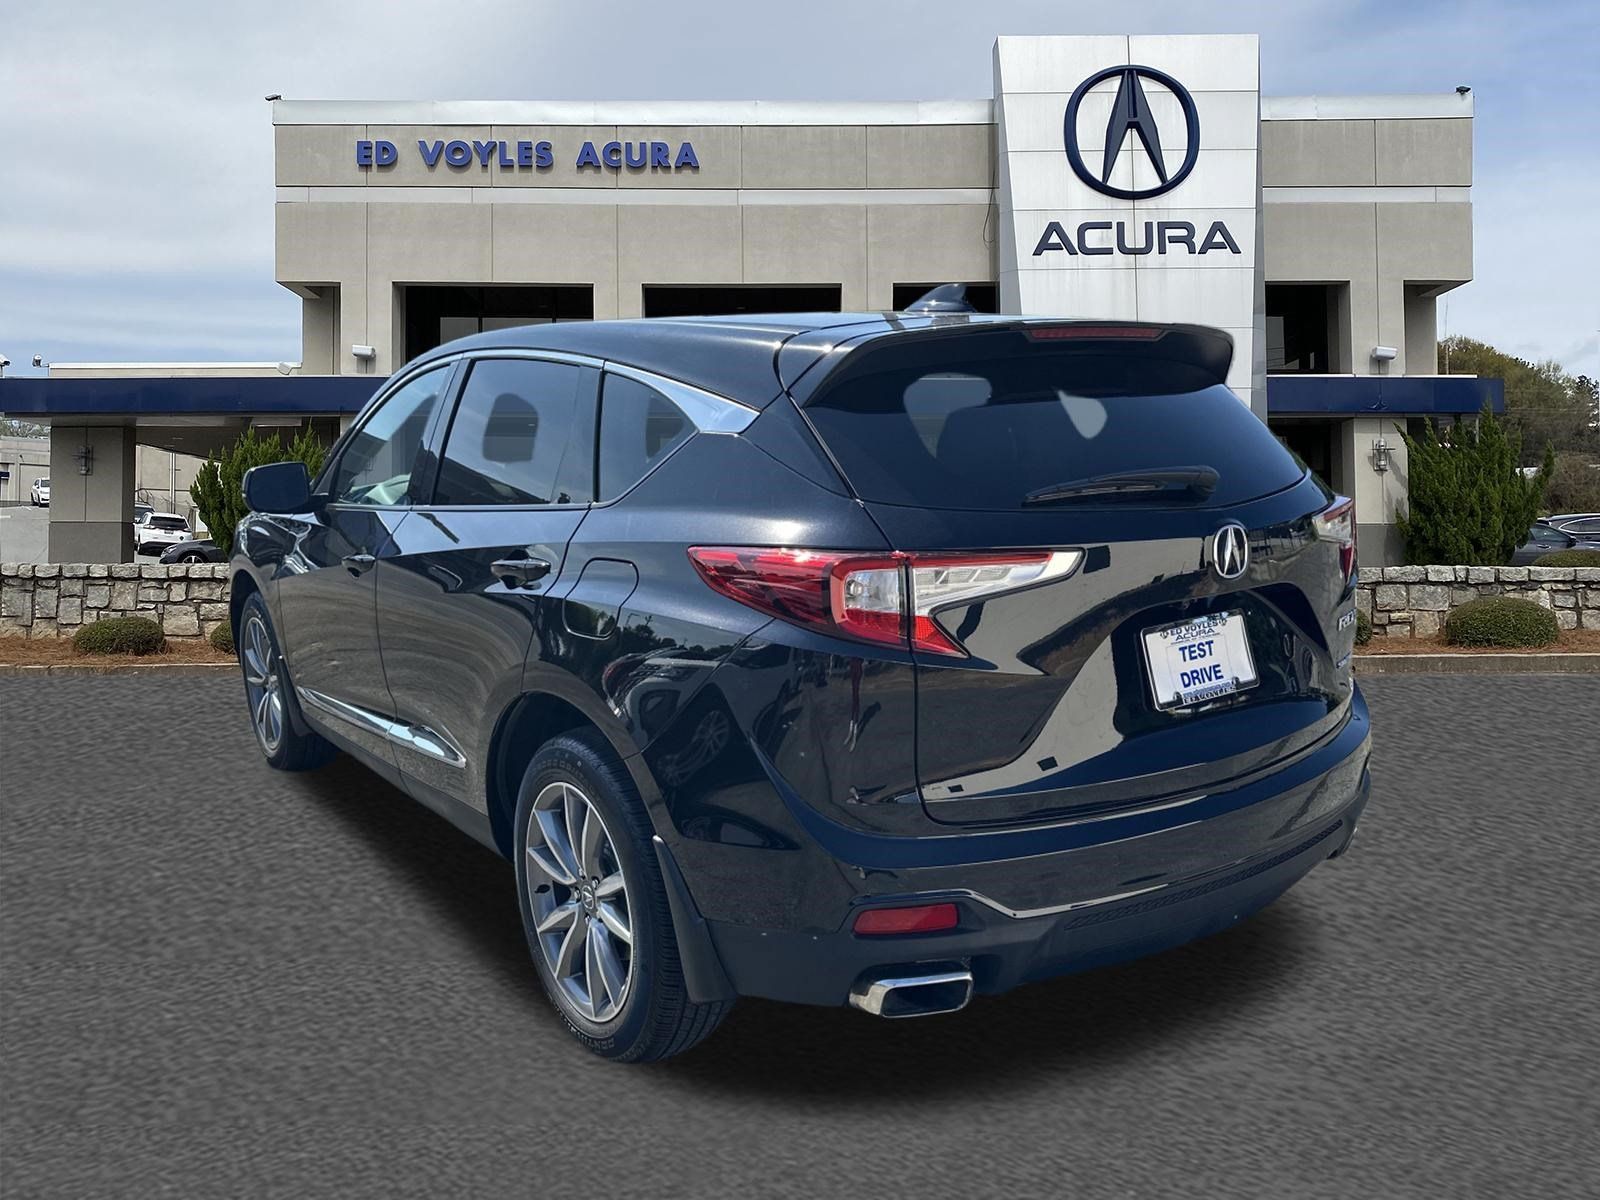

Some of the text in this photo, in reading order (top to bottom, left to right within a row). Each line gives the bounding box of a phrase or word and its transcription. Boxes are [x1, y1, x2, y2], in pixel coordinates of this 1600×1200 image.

[356, 140, 700, 169] ED VOYLES ACURA
[1032, 221, 1242, 256] ACURA
[1170, 619, 1219, 637] ED VOYLES
[1175, 628, 1215, 642] ACURA
[1179, 640, 1214, 662] TEST
[1180, 664, 1224, 689] DRIVE
